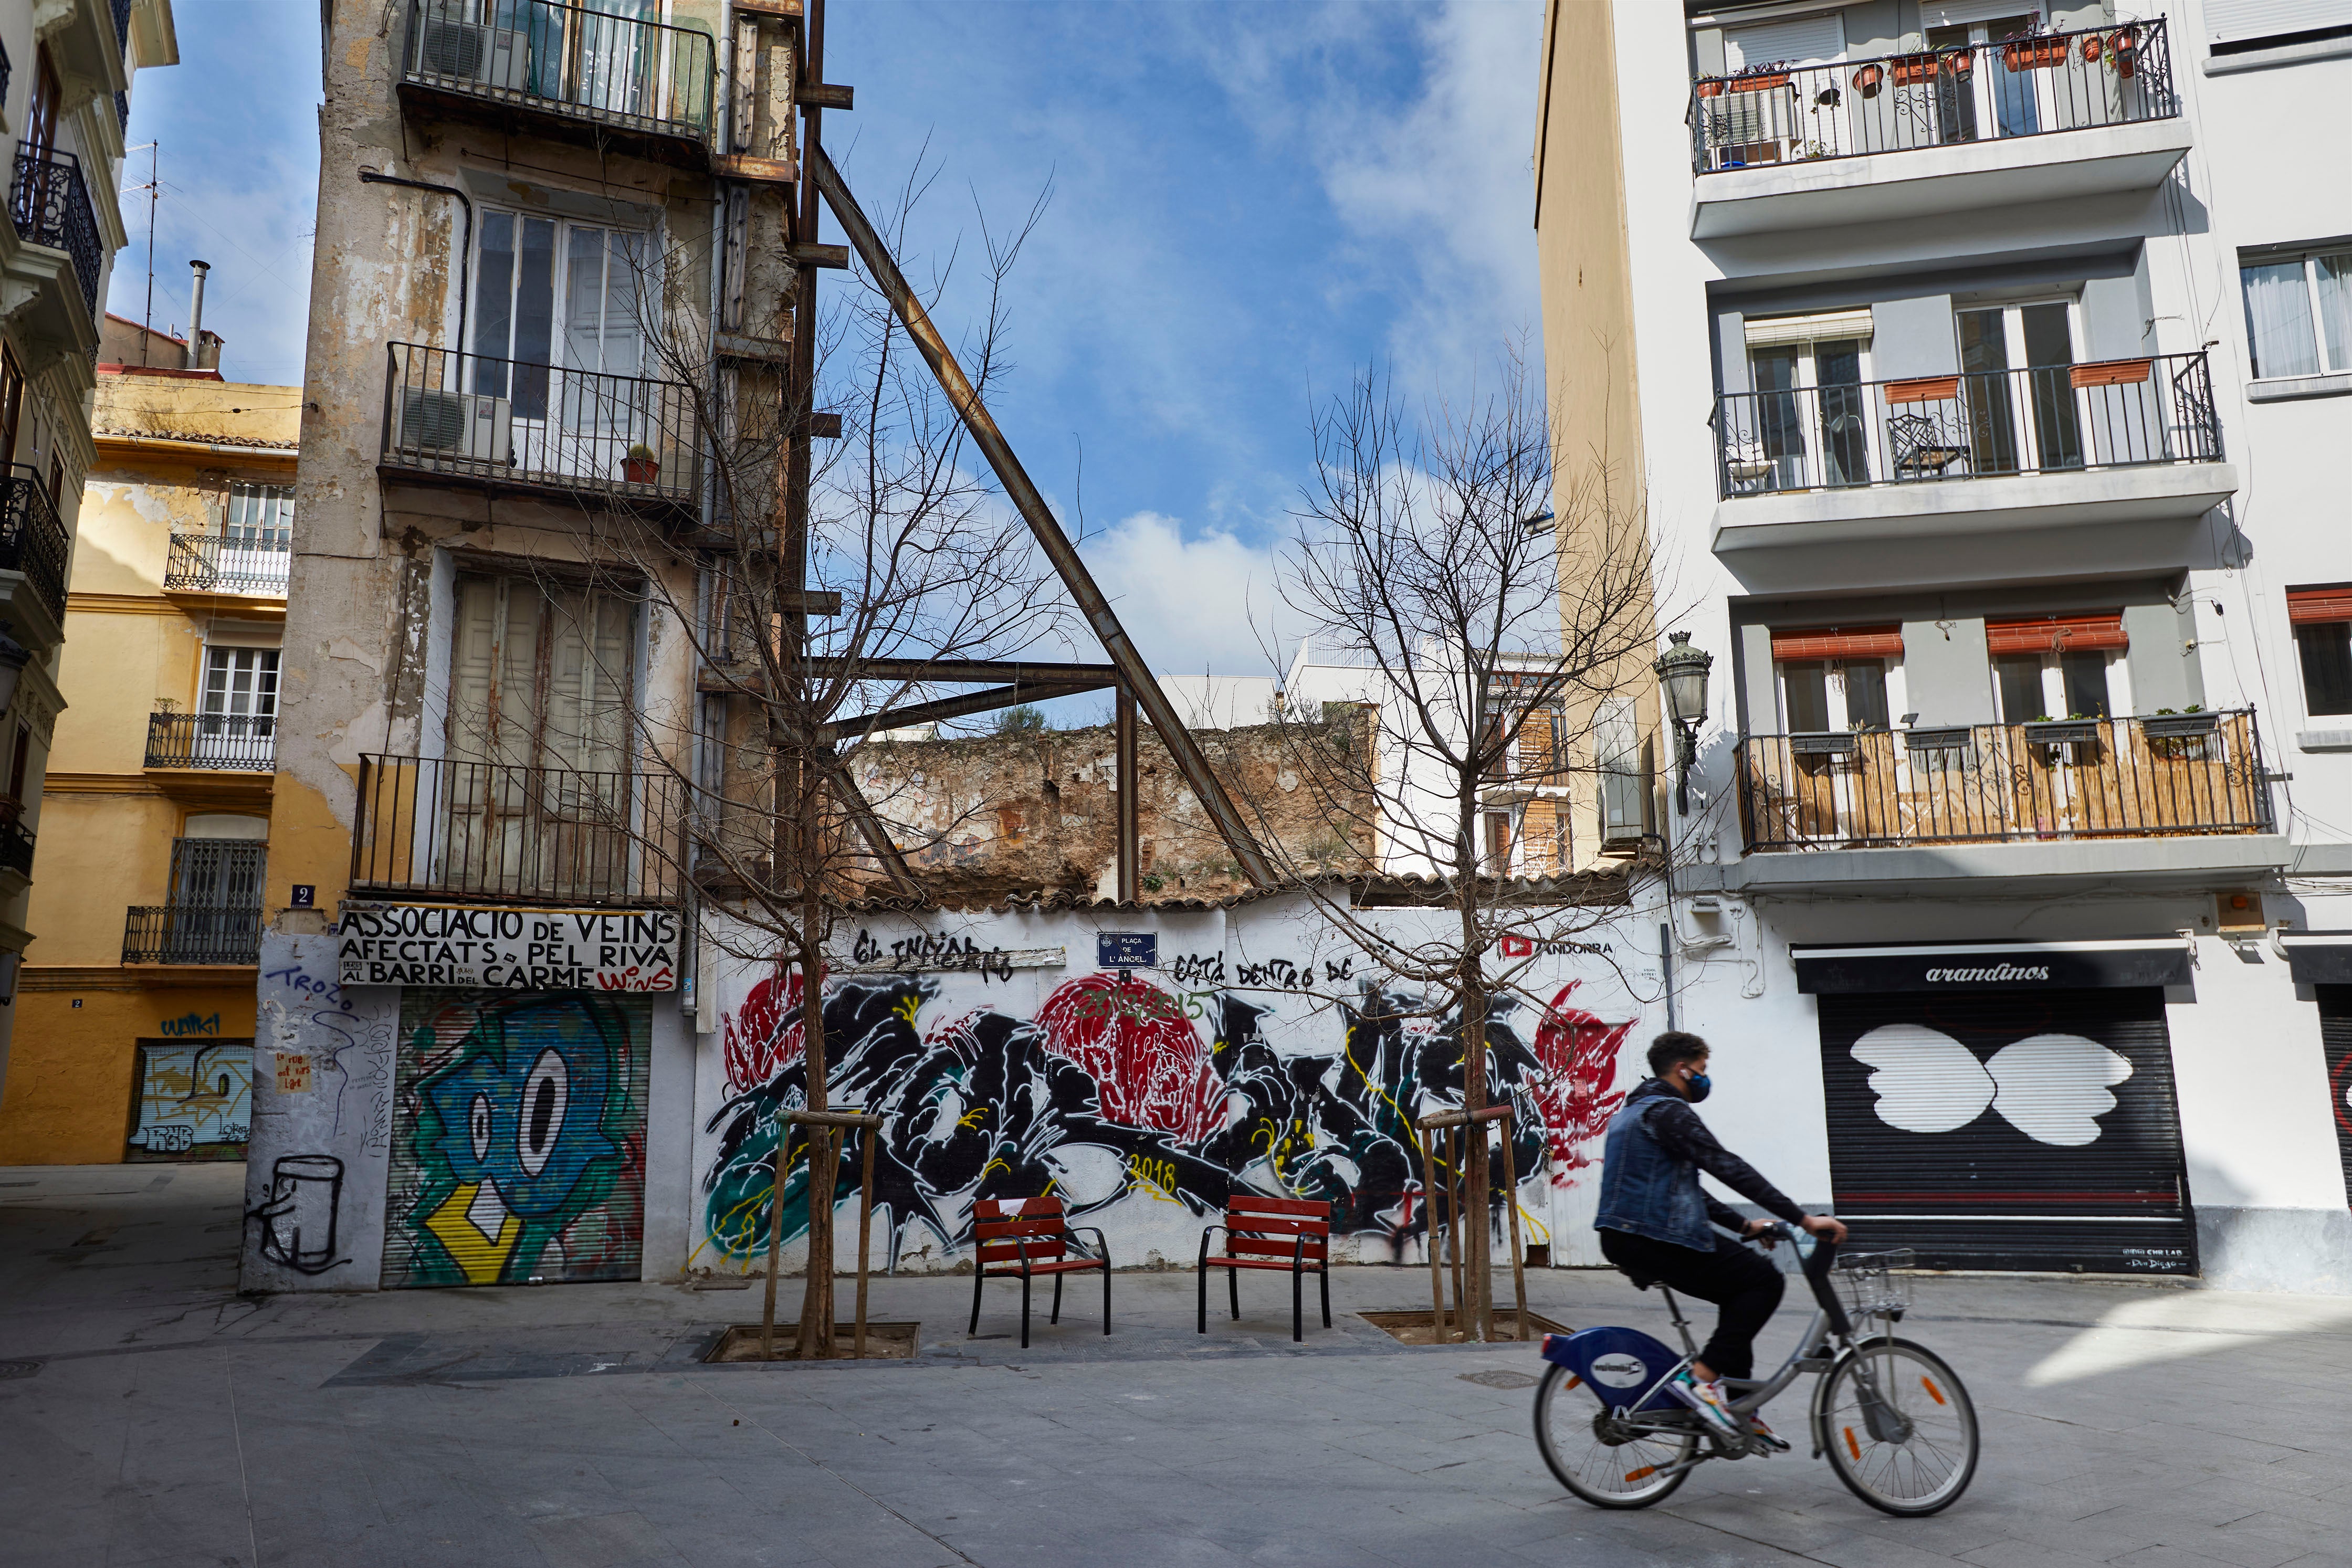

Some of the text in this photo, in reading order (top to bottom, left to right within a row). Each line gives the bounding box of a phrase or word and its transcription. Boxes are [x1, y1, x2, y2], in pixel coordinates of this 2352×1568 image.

[298, 887, 308, 902] 2
[339, 907, 676, 944] ASSOCIACIO DE VEINS
[339, 939, 674, 967] AFECTATS PEL RIVA
[1535, 937, 1613, 955] ANDORRA
[342, 961, 595, 988] AL BARRI DEL CARME
[1926, 963, 2049, 982] arandinos
[288, 1056, 303, 1064] rue
[277, 1066, 290, 1077] est
[1130, 1153, 1175, 1194] 2018
